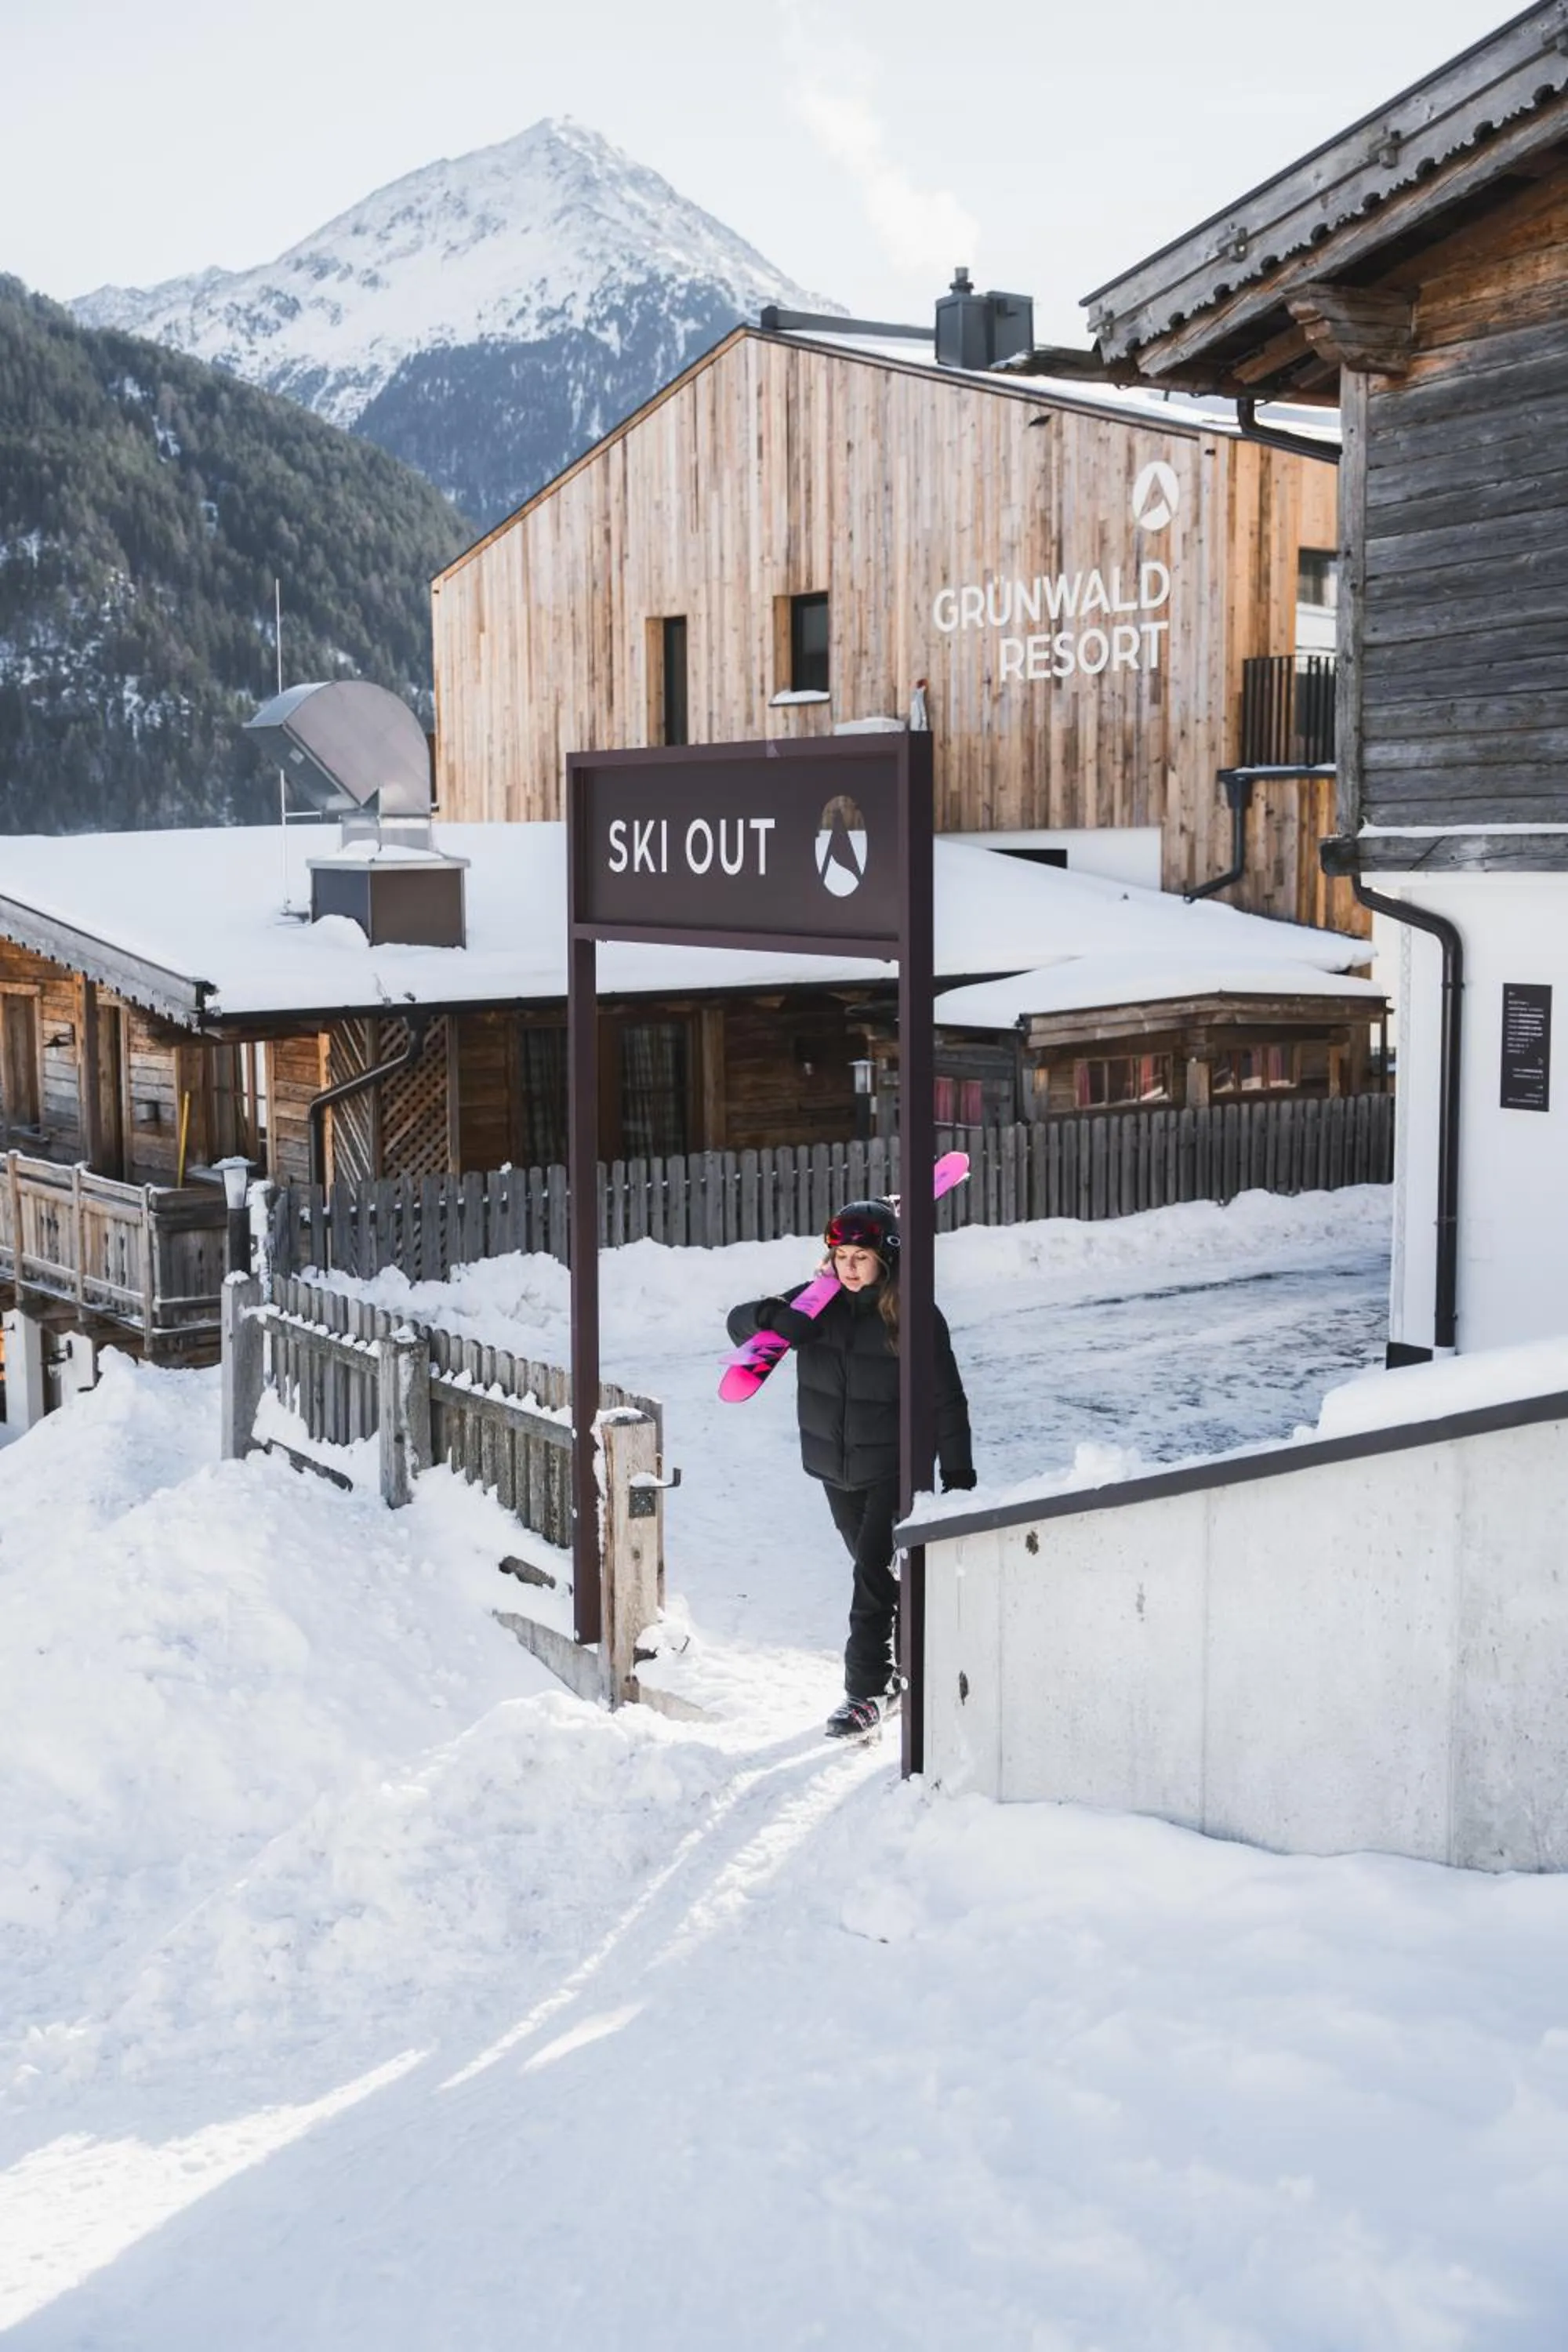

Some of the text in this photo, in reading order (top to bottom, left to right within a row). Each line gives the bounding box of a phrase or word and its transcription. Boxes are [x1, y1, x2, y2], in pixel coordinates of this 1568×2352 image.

[933, 561, 1171, 633] GRÜNWALD
[999, 621, 1168, 681] RESORT
[608, 818, 775, 875] SKI OUT
